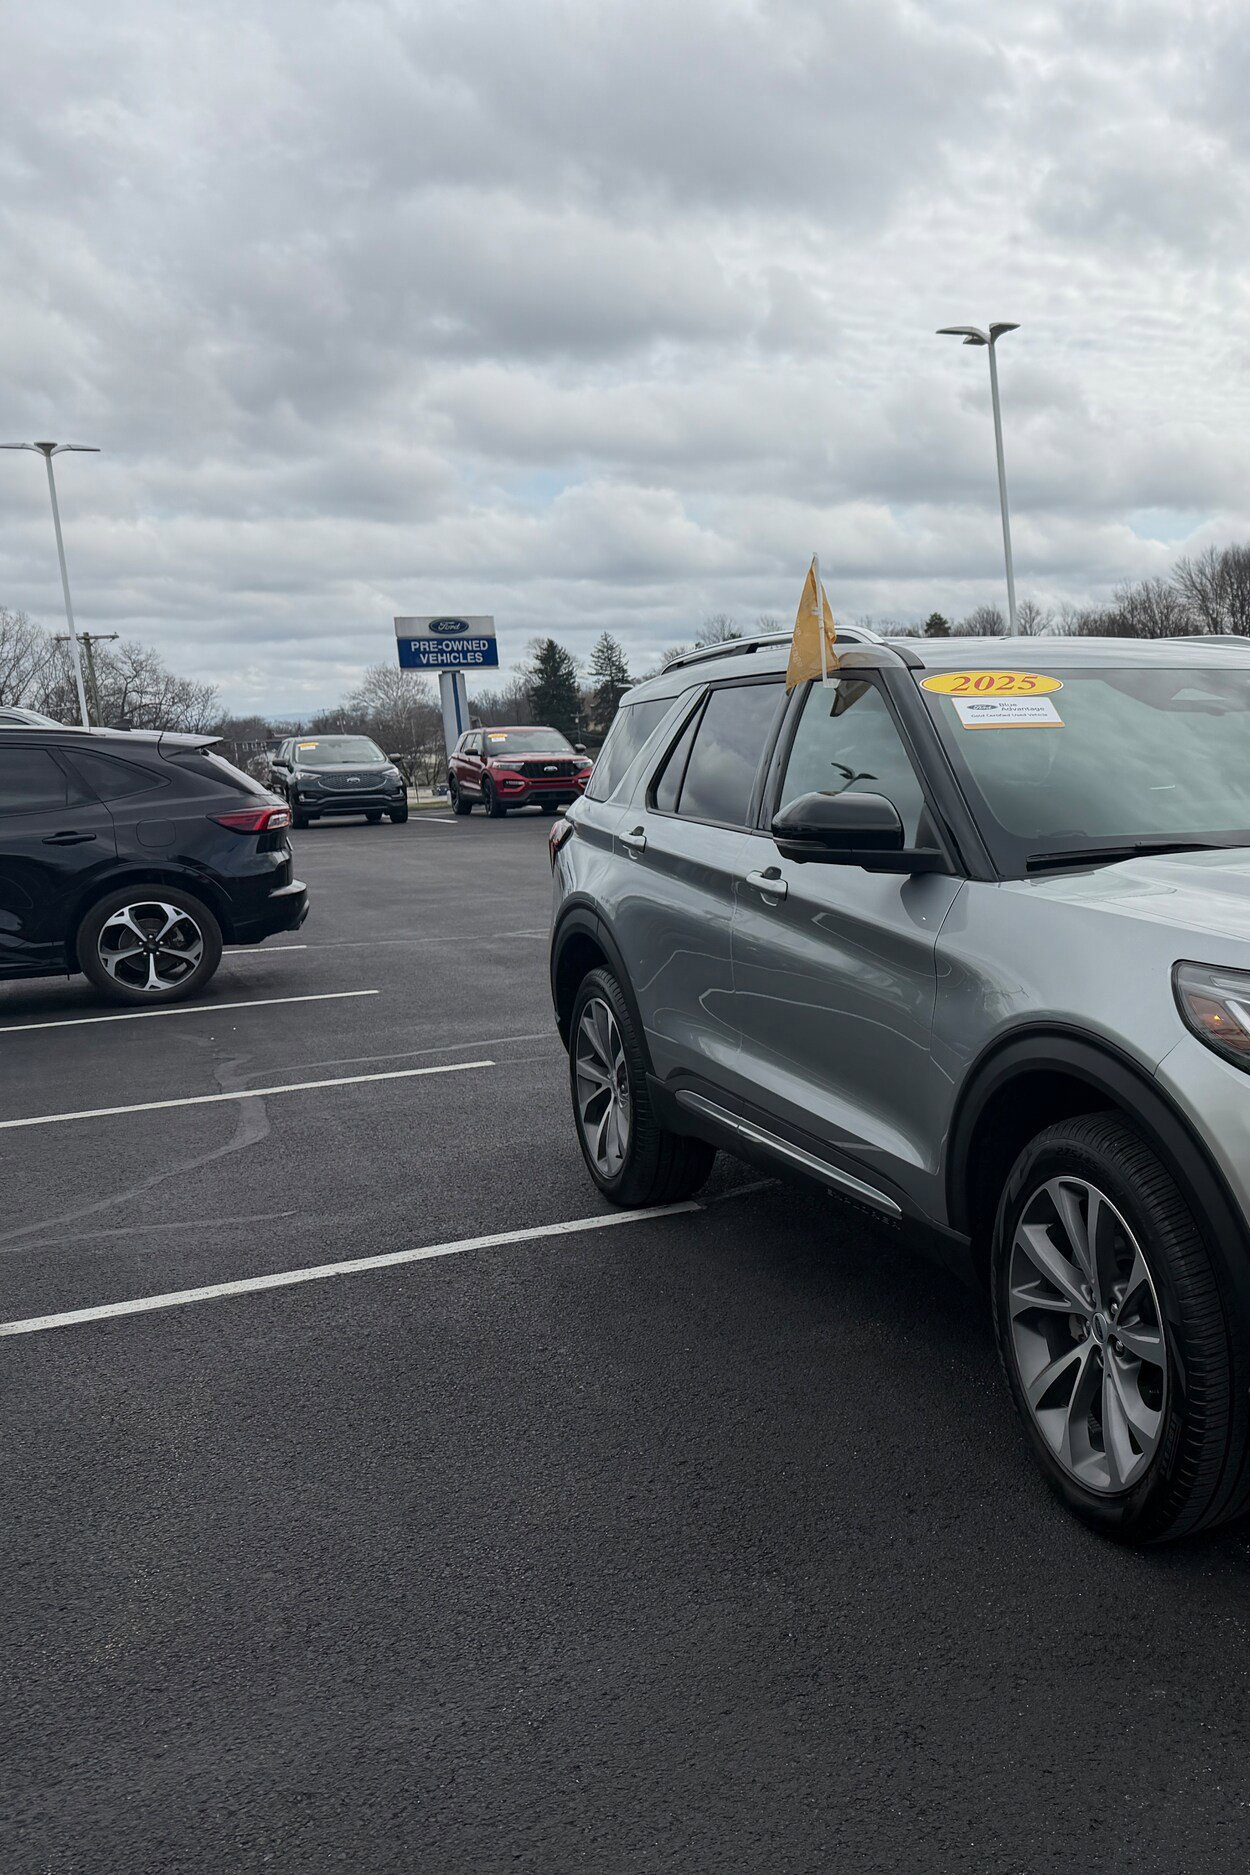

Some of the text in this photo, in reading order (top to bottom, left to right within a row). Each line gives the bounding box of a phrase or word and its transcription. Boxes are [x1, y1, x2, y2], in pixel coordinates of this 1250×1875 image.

[410, 640, 489, 652] PRE-OWNED
[420, 652, 484, 664] VEHICLES
[950, 674, 1039, 692] 2025
